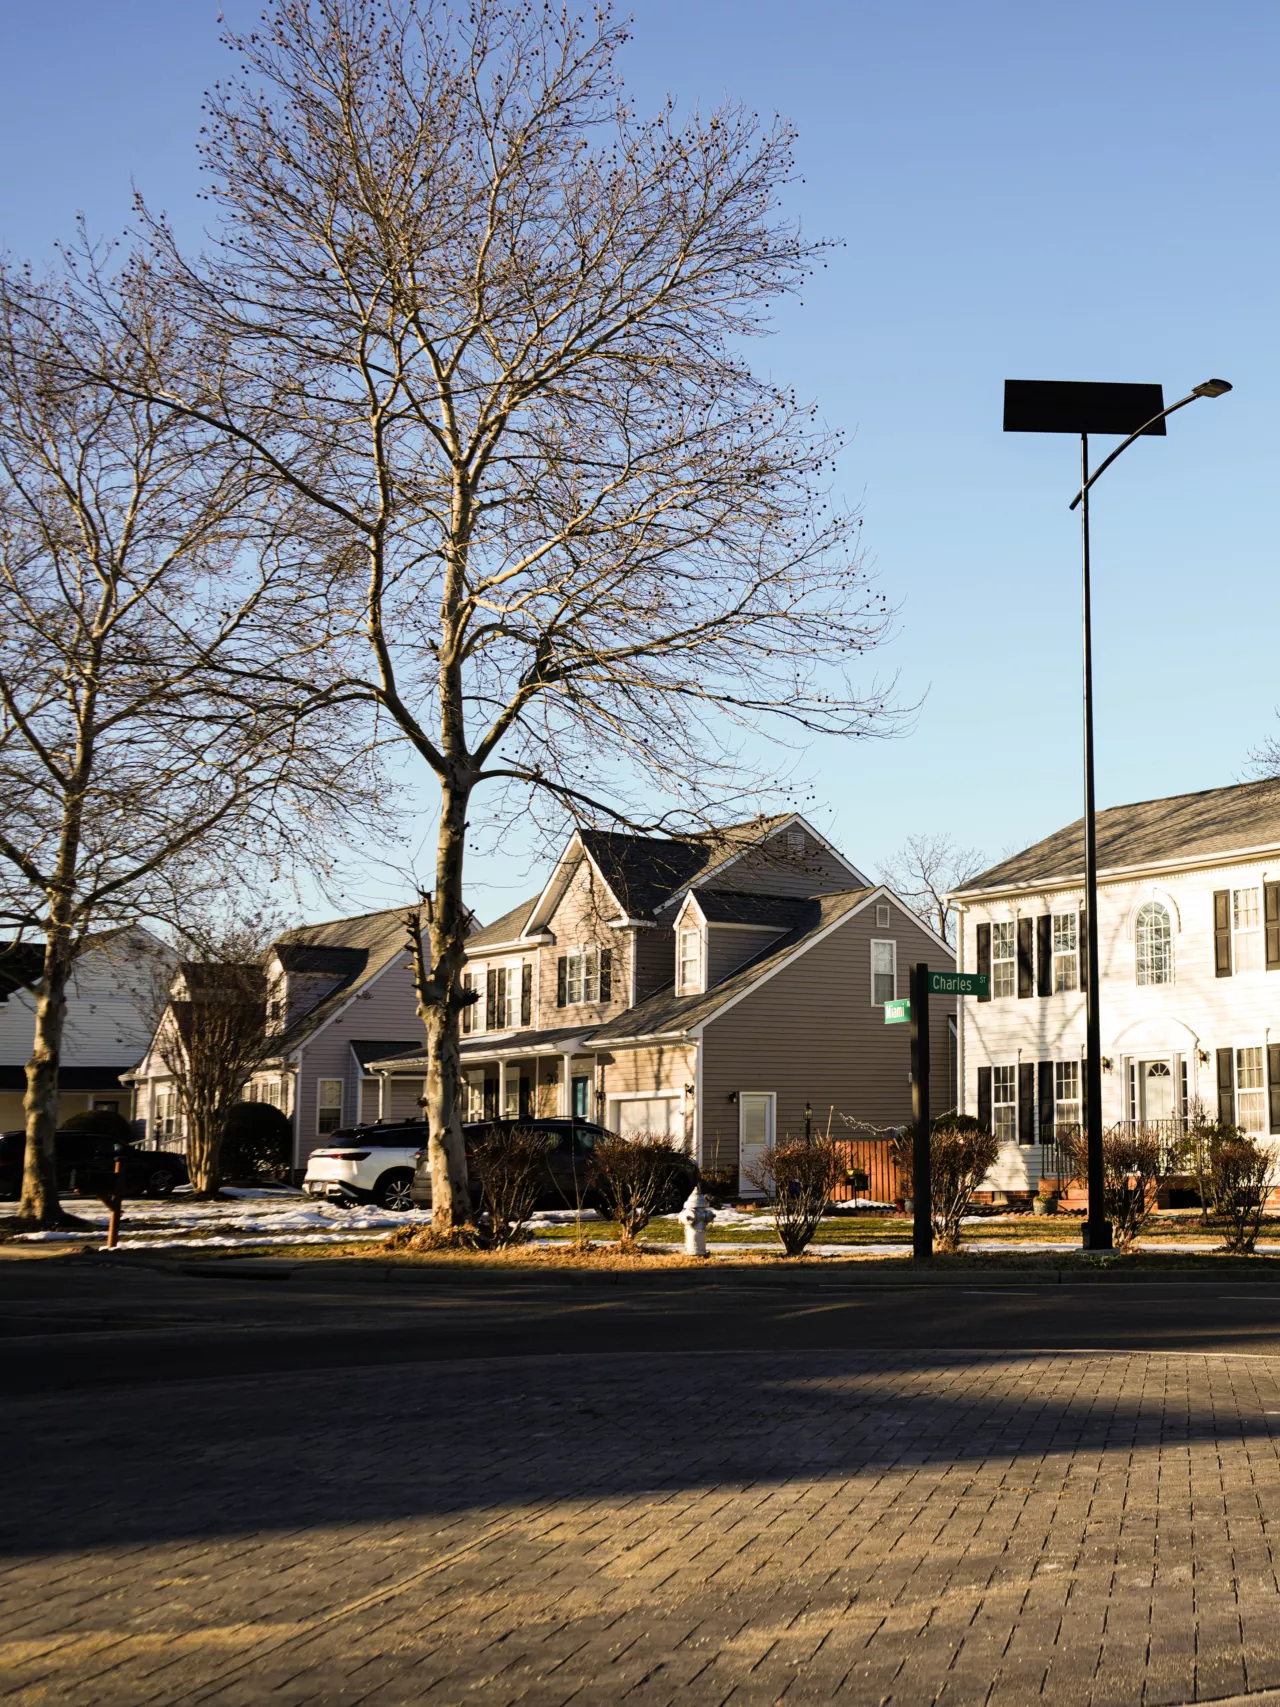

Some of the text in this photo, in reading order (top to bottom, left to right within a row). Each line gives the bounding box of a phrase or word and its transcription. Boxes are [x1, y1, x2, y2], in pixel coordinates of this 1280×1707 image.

[933, 975, 986, 991] Charles ST
[886, 1003, 905, 1018] Miami
